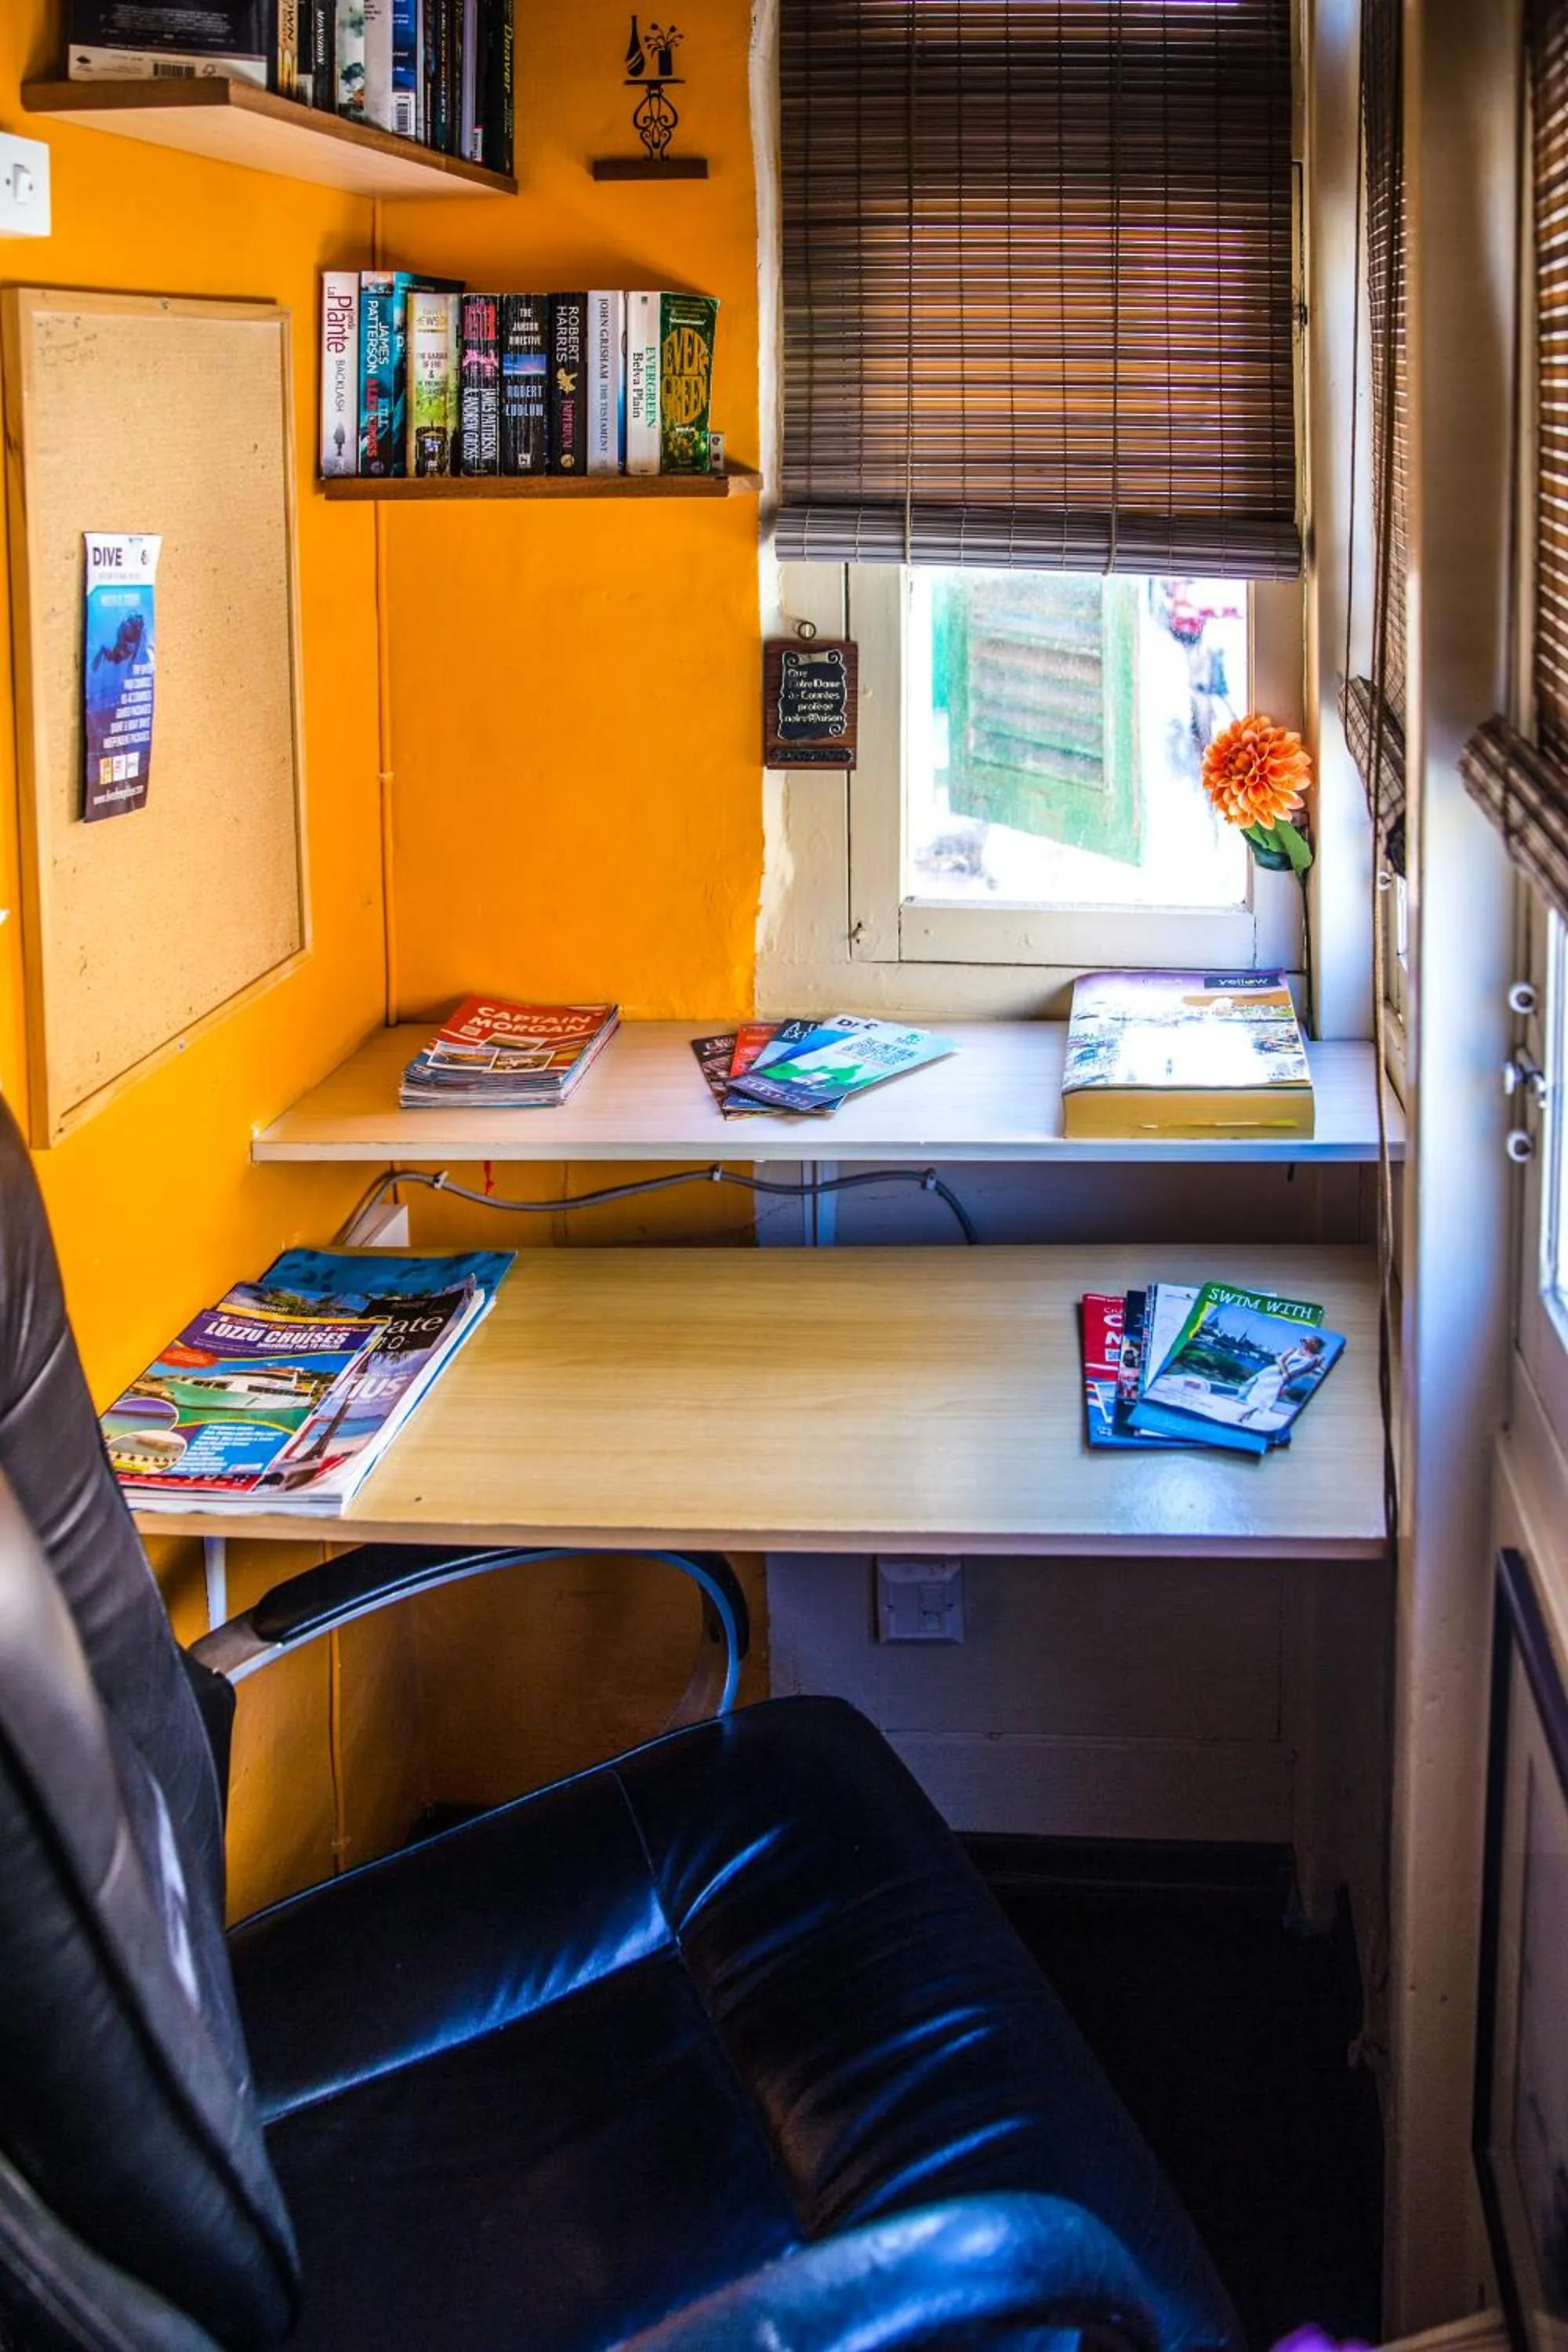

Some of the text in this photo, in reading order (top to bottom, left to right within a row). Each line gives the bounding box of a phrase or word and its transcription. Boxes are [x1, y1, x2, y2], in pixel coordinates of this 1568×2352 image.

[316, 9, 325, 65] MONSOON
[503, 24, 514, 94] Deaver
[327, 296, 352, 354] Plante
[367, 300, 379, 374] PATTERSON
[379, 322, 390, 365] JAMES
[556, 306, 567, 363] HARRIS
[568, 306, 579, 363] ROBERT
[336, 360, 346, 412] BACKLASH
[506, 385, 543, 397] ROBERT
[598, 299, 609, 452] JOHN GRISHAM THE TESTAMENT
[633, 352, 644, 418] Belva Plain
[645, 347, 656, 429] EVERGREEN
[367, 378, 378, 457] ALEX CROSS
[463, 397, 479, 430] ANDREW
[481, 388, 496, 459] JAMES PATTERSON
[506, 404, 543, 416] LUDLUM
[463, 432, 479, 459] GROSS
[93, 546, 123, 566] DIVE
[1218, 977, 1269, 987] yellow
[469, 1017, 586, 1033] MORGAN
[477, 1007, 592, 1024] CAPTAIN
[1208, 1288, 1313, 1319] SWIM WITH
[204, 1322, 351, 1345] LUZZU CRUISES
